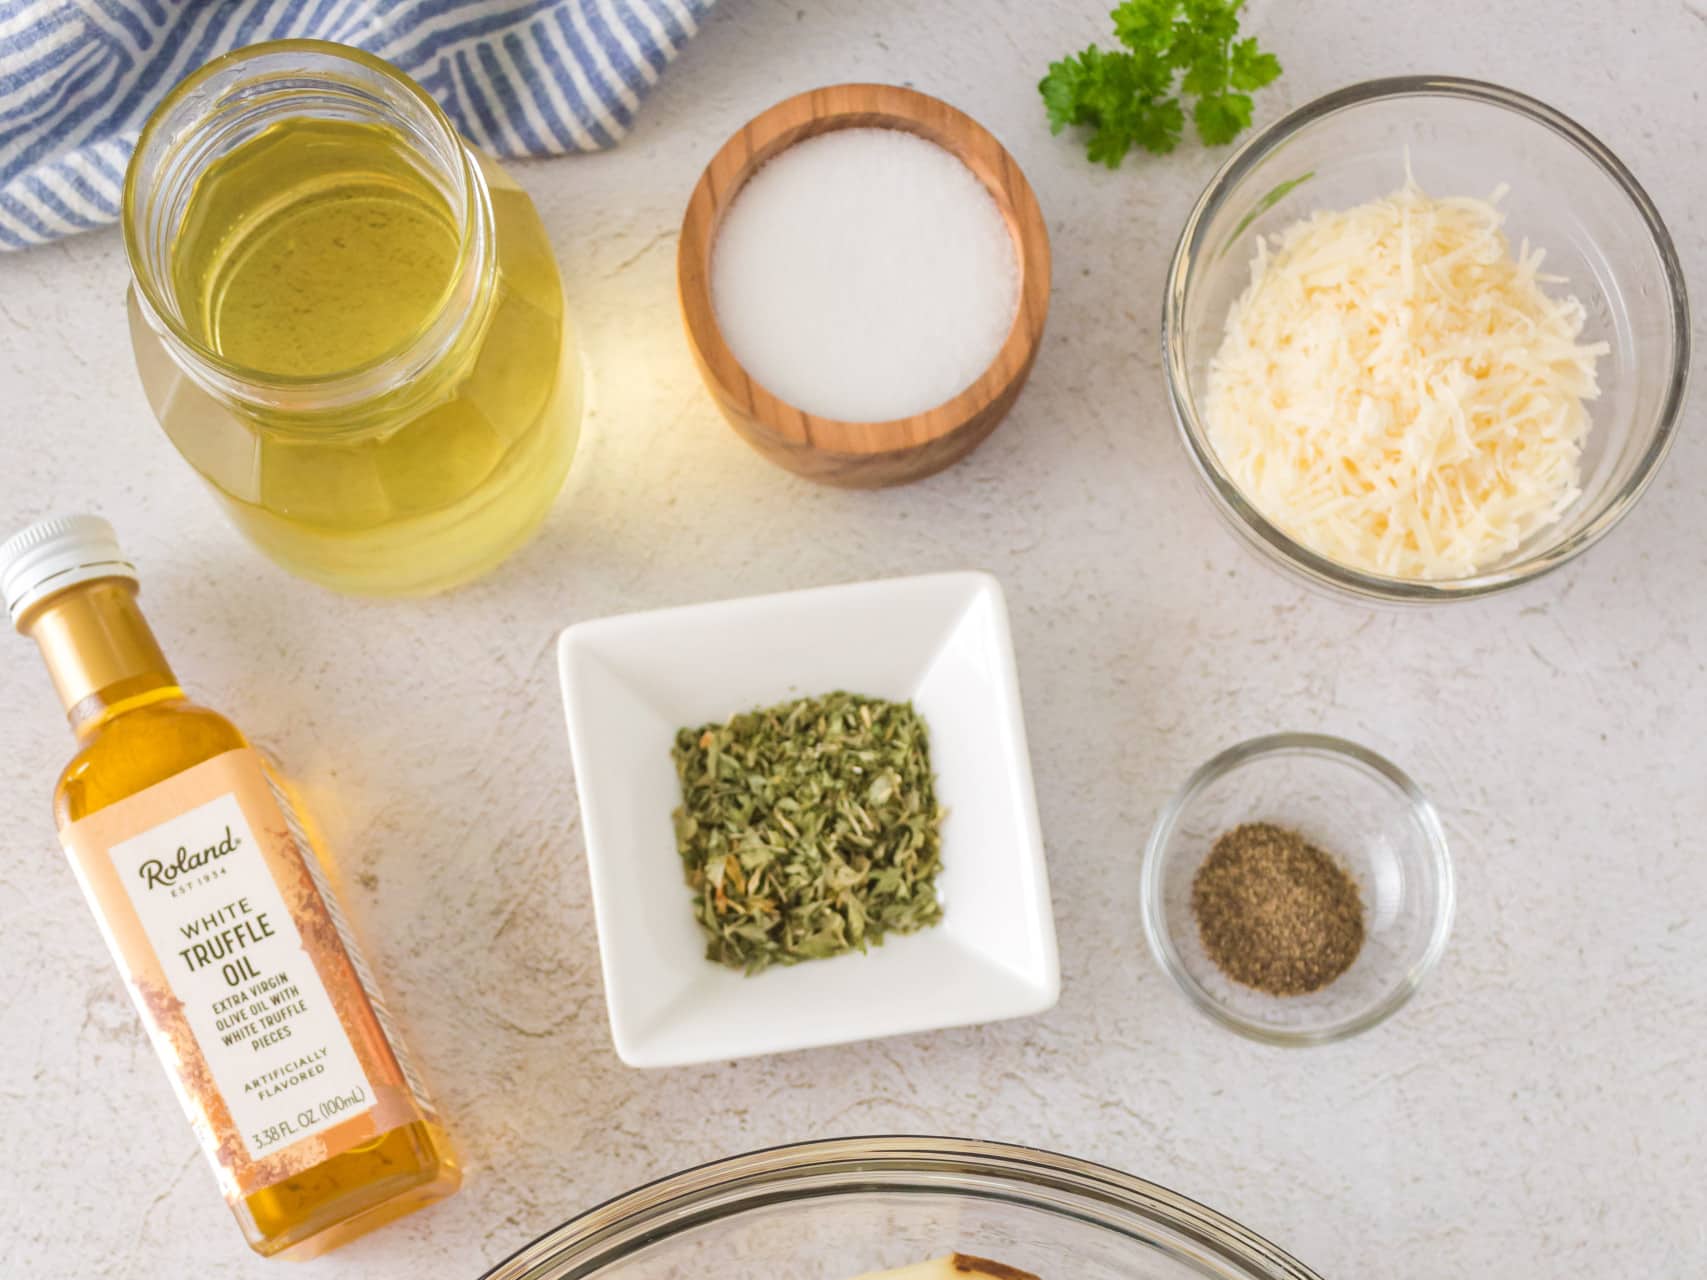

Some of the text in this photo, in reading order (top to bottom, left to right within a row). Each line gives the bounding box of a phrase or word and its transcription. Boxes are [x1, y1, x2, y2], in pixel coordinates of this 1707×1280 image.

[138, 826, 237, 890] Roland
[171, 881, 193, 898] EST
[179, 897, 253, 939] WHITE
[178, 913, 276, 972] TRUFFLE
[211, 971, 289, 1015] EXTRA VIRGIN
[222, 955, 260, 987] OIL
[215, 985, 300, 1032] OLIVE OIL WITH
[221, 999, 308, 1047] WHITE TRUFFLE
[251, 1025, 292, 1052] PIECES
[243, 1047, 329, 1094] ARTIFICIALLY
[257, 1064, 325, 1101] FLAVORED
[252, 1085, 366, 1149] 3.38 FL. OZ. (100mL)
